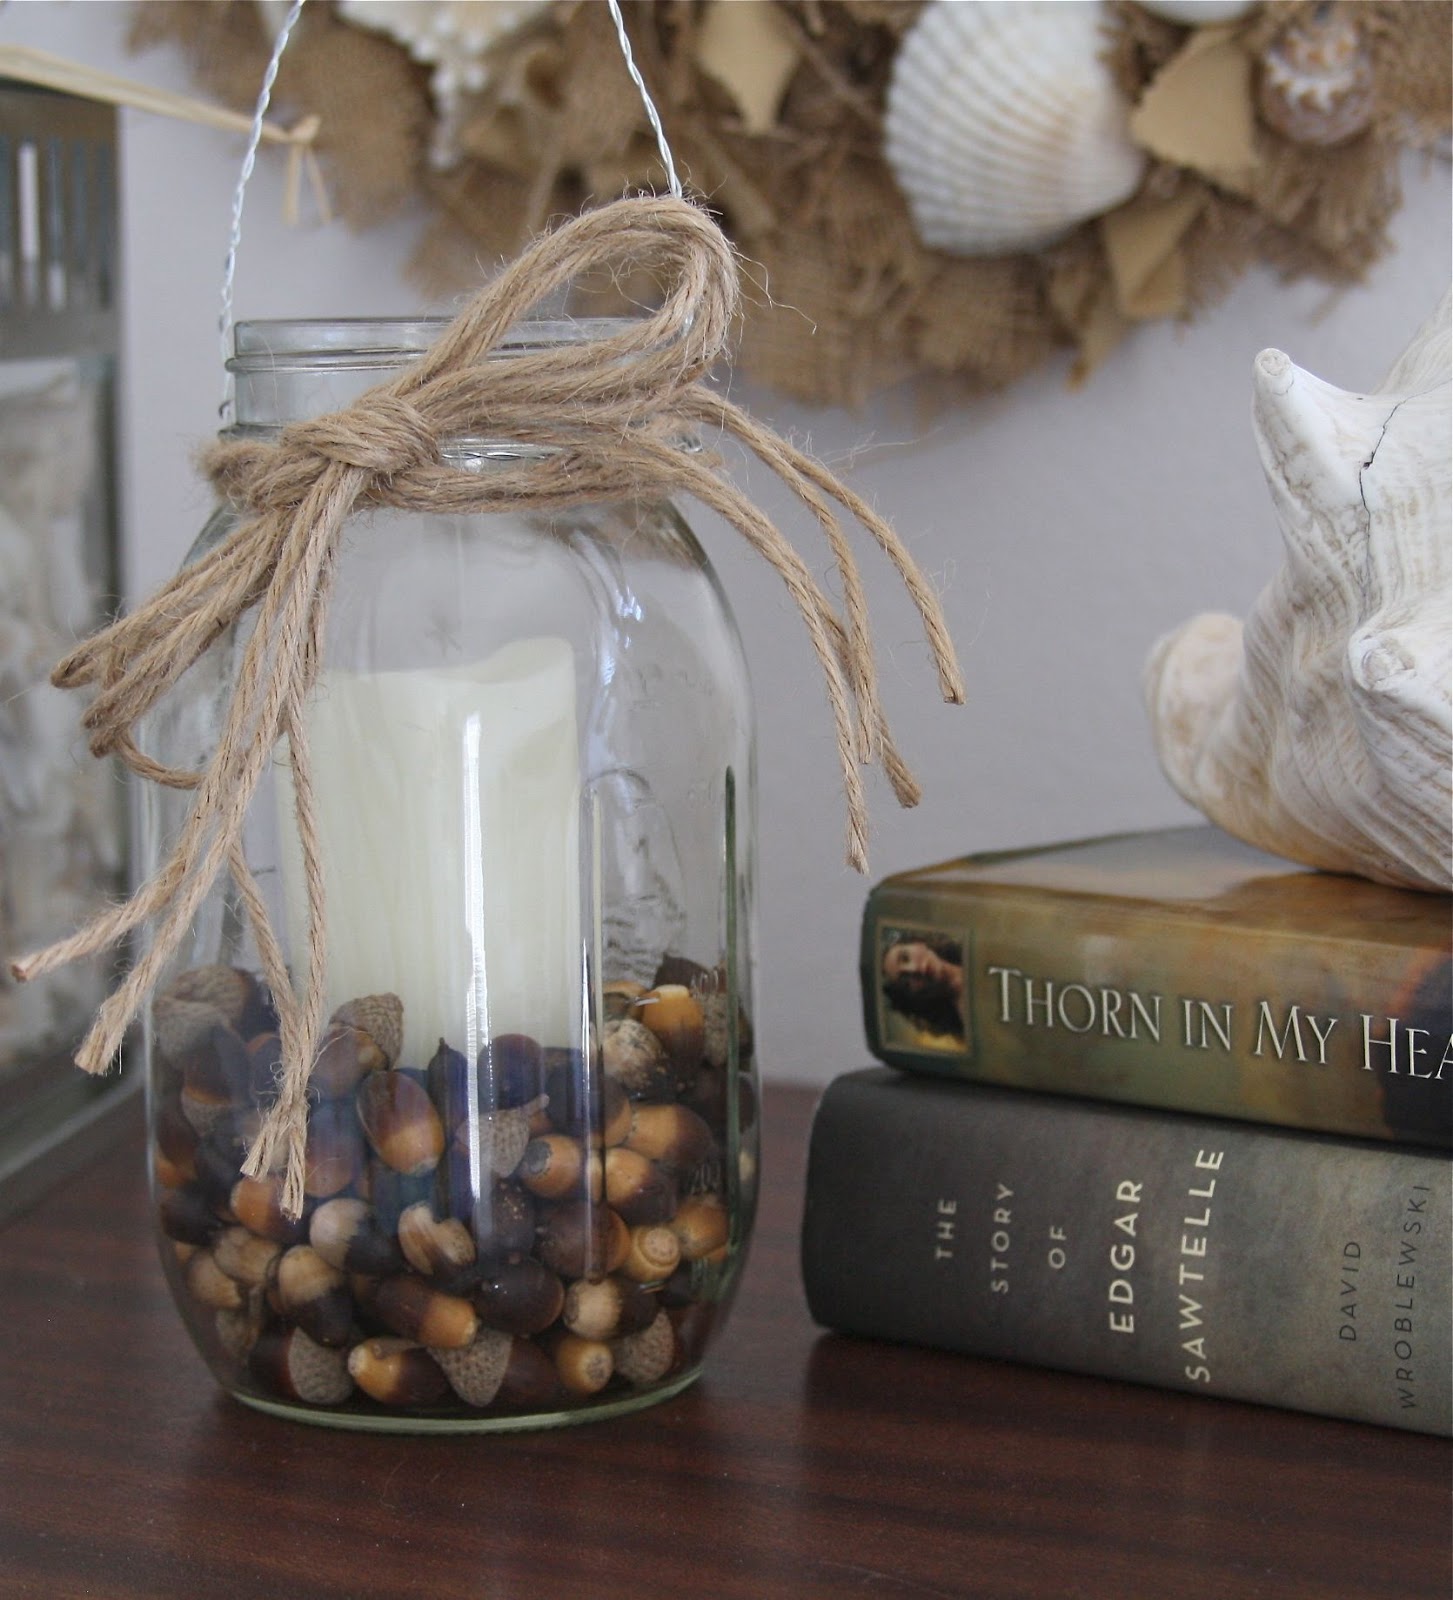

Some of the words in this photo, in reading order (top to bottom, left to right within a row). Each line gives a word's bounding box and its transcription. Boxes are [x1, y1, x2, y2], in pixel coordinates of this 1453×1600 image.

[988, 966, 1164, 1043] THORN
[1182, 998, 1234, 1051] IN
[1253, 1000, 1339, 1065] MY
[935, 1199, 957, 1259] THE
[990, 1182, 1014, 1294] STORY
[1048, 1225, 1067, 1269] OF
[1108, 1180, 1143, 1333] EDGAR
[1178, 1149, 1224, 1383] SAWTELLE
[1339, 1242, 1361, 1341] DAVID
[1394, 1185, 1431, 1409] WROBLEWSKI
